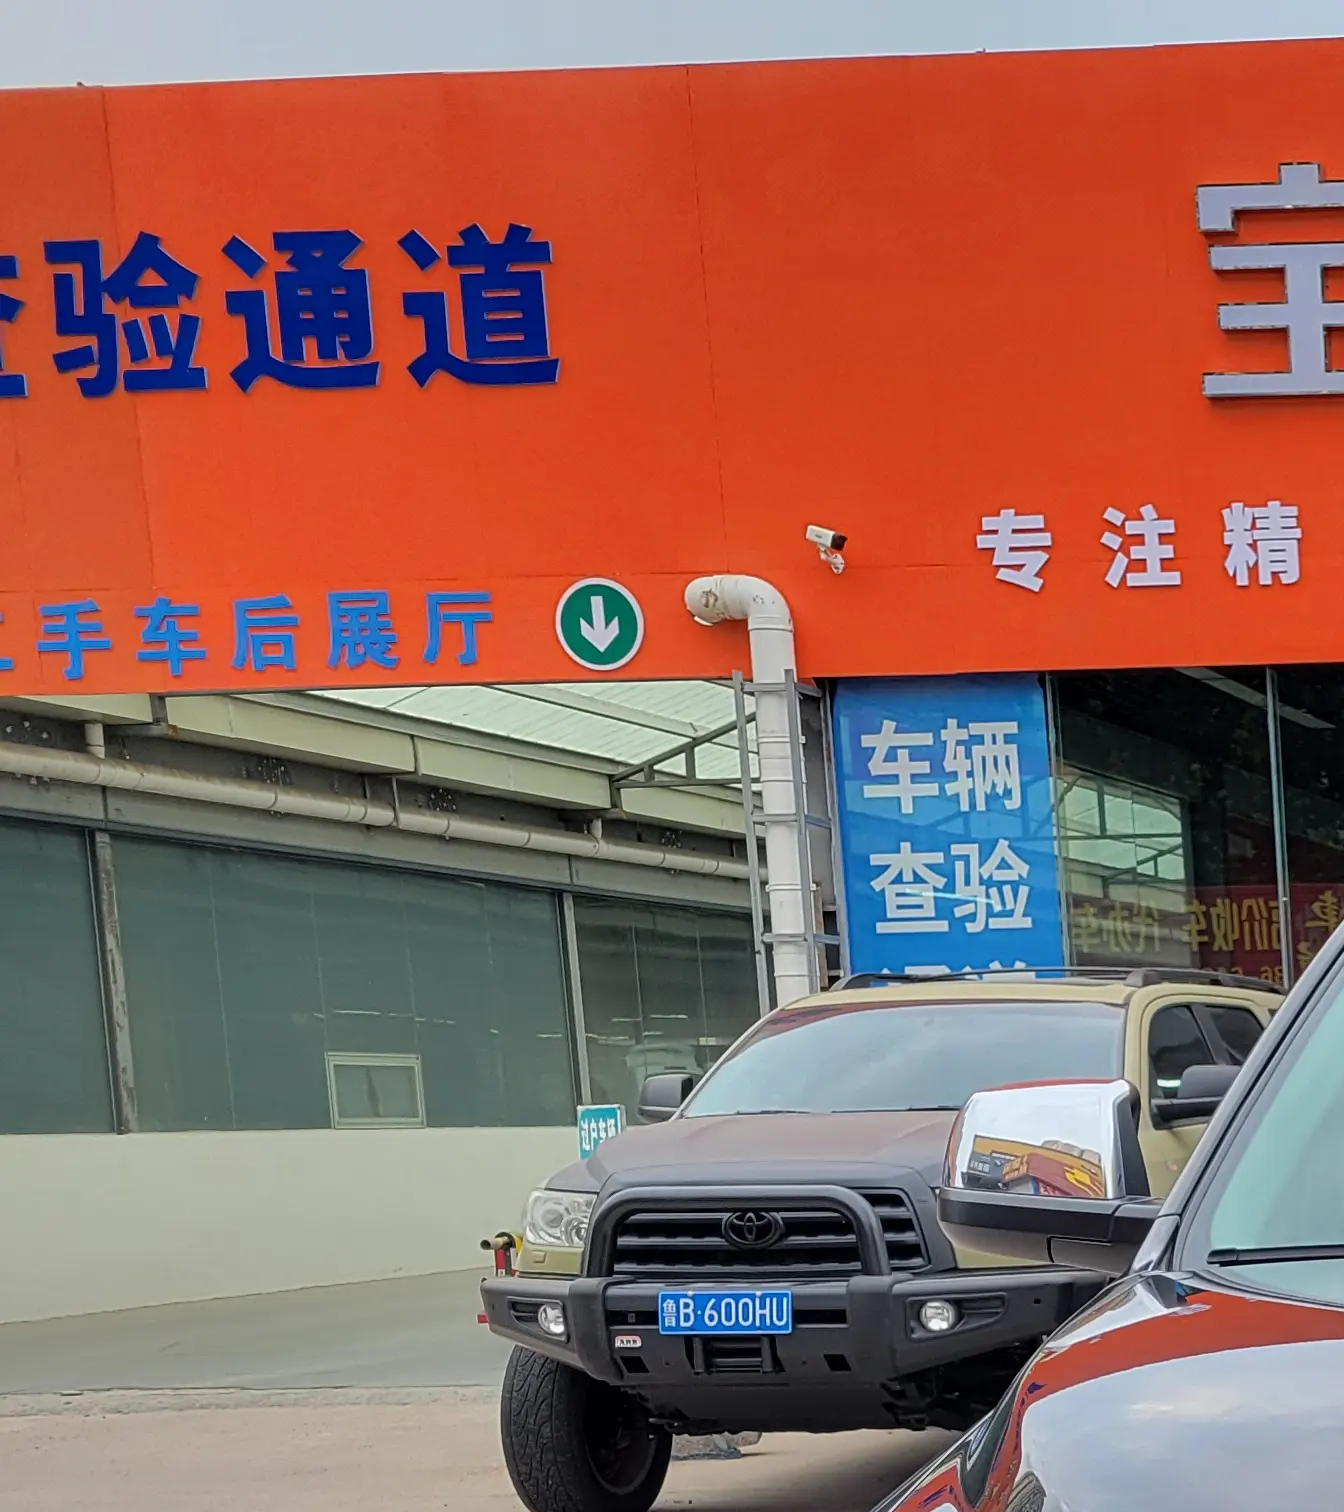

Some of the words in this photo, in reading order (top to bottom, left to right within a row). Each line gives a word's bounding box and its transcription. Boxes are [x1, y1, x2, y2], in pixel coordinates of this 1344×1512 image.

[0, 222, 560, 398] 验通道
[0, 589, 494, 680] 手车后展厅
[860, 717, 1023, 814] 车辆
[869, 838, 1034, 937] 查验
[662, 1297, 788, 1328] 鲁B·600HU
